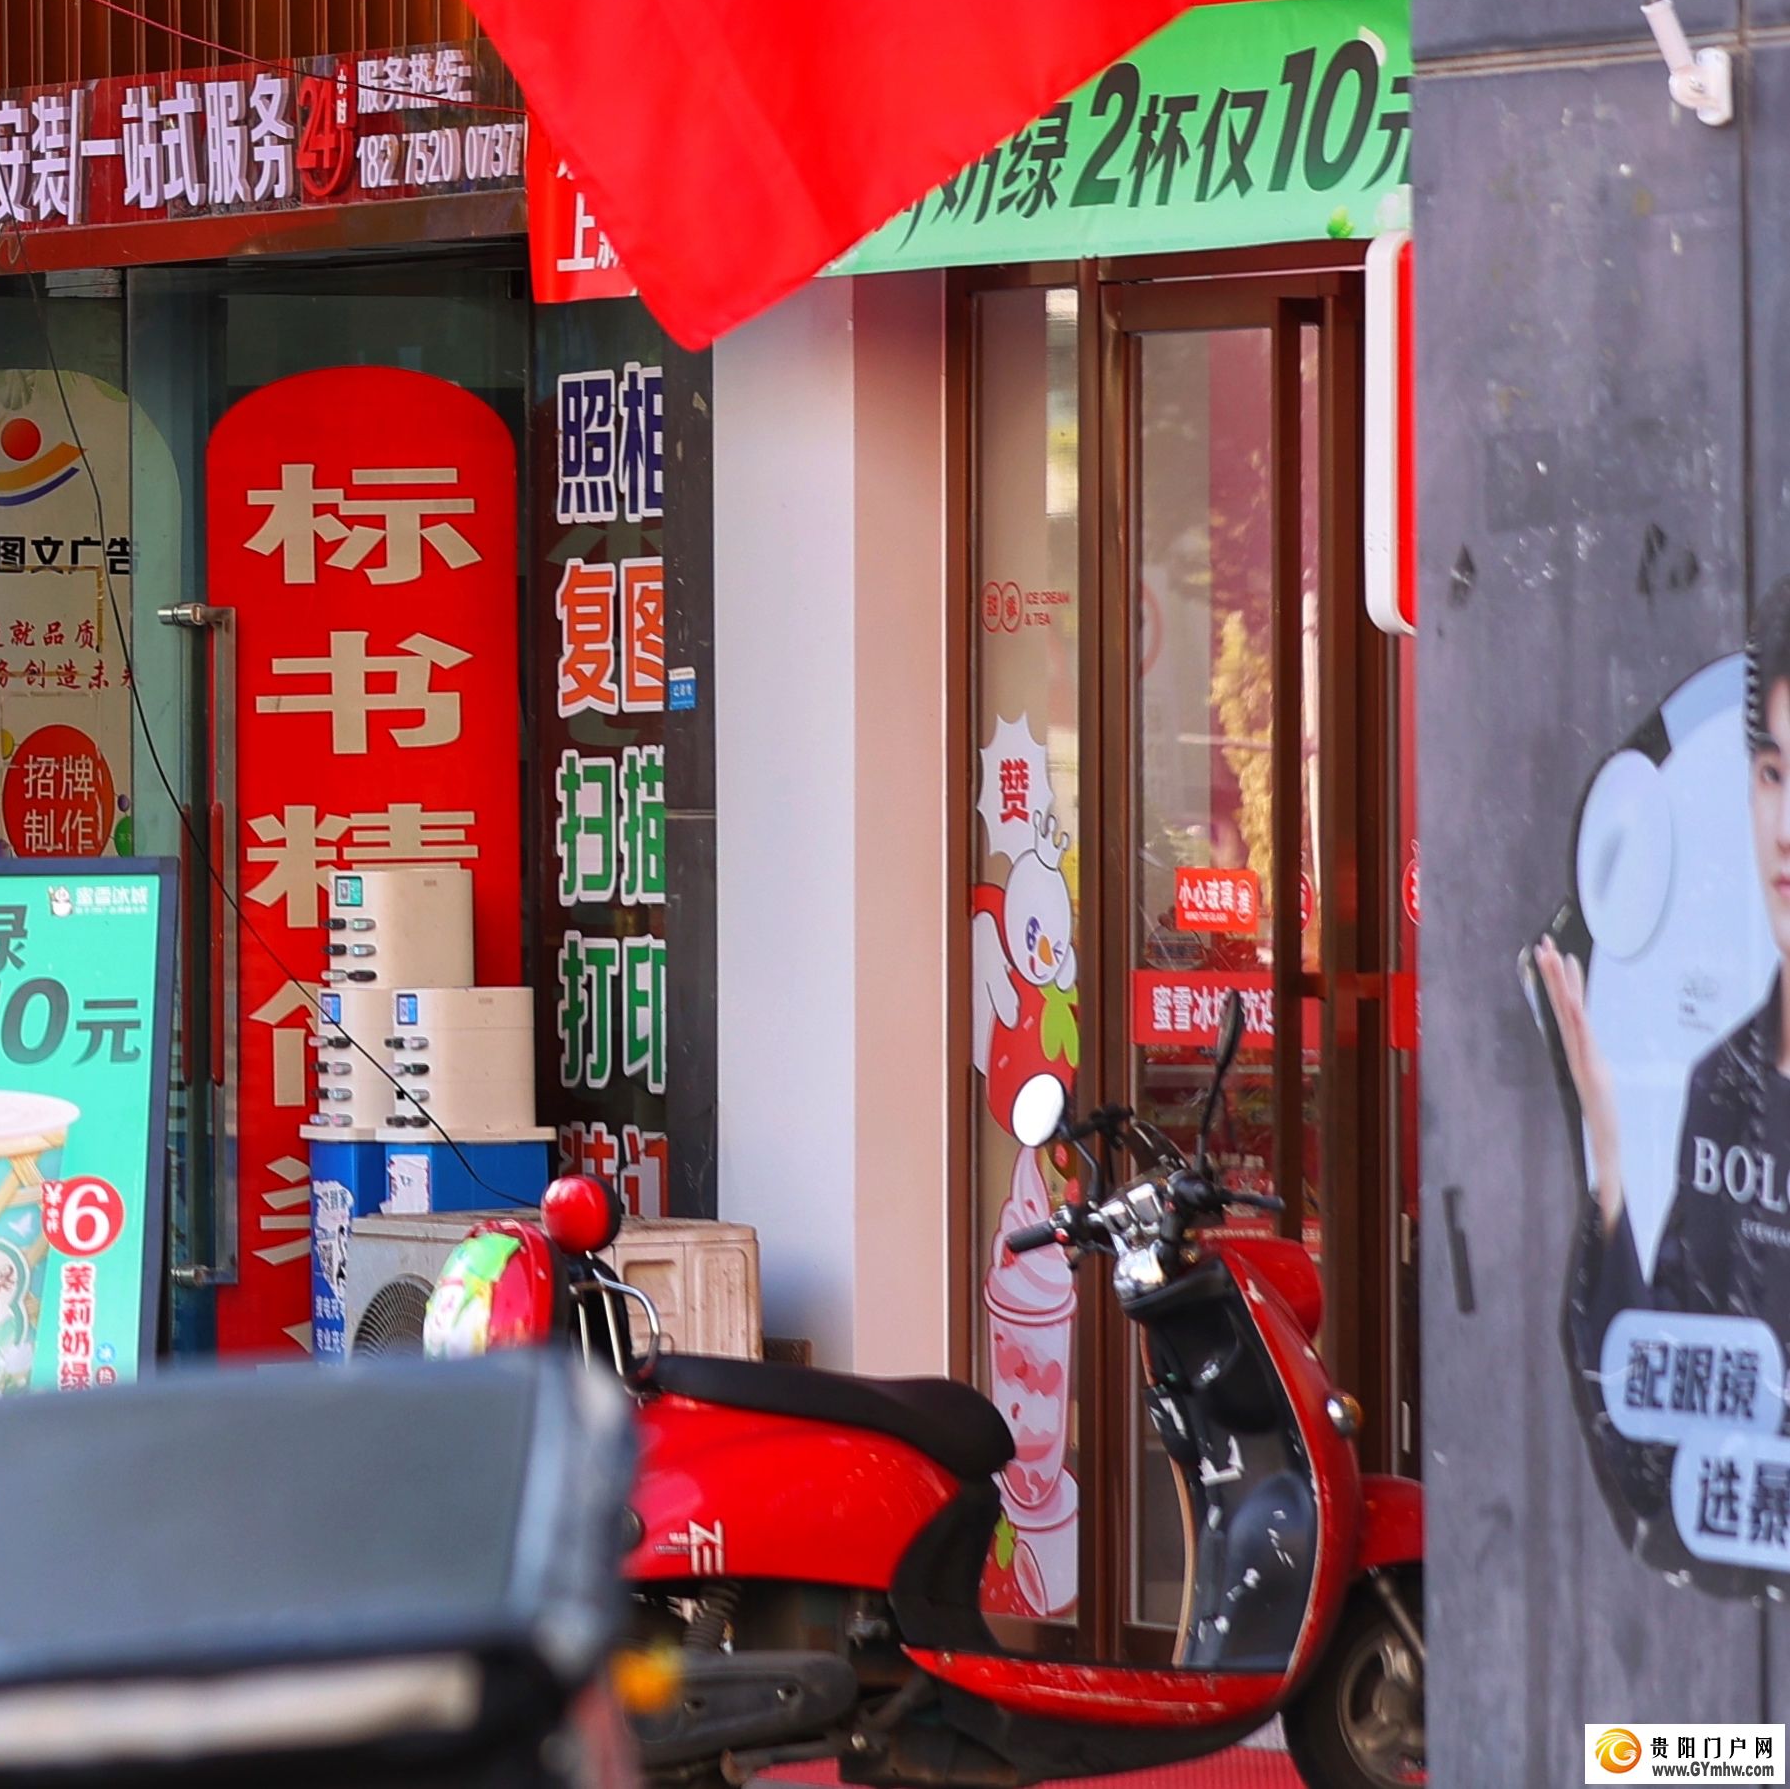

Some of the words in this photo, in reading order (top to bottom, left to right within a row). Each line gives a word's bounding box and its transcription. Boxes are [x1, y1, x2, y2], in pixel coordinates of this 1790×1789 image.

[297, 76, 337, 170] 24
[356, 134, 400, 189] 182
[402, 127, 463, 186] 7520
[464, 122, 524, 181] 0737
[558, 361, 663, 523] 照相
[23, 753, 97, 801] 招牌
[998, 758, 1030, 824] 赞
[22, 807, 97, 854] 制作
[557, 745, 666, 907] 扫描
[558, 930, 667, 1095] 打印
[1693, 1135, 1790, 1213] BOL
[1624, 1339, 1760, 1421] 配眼镜
